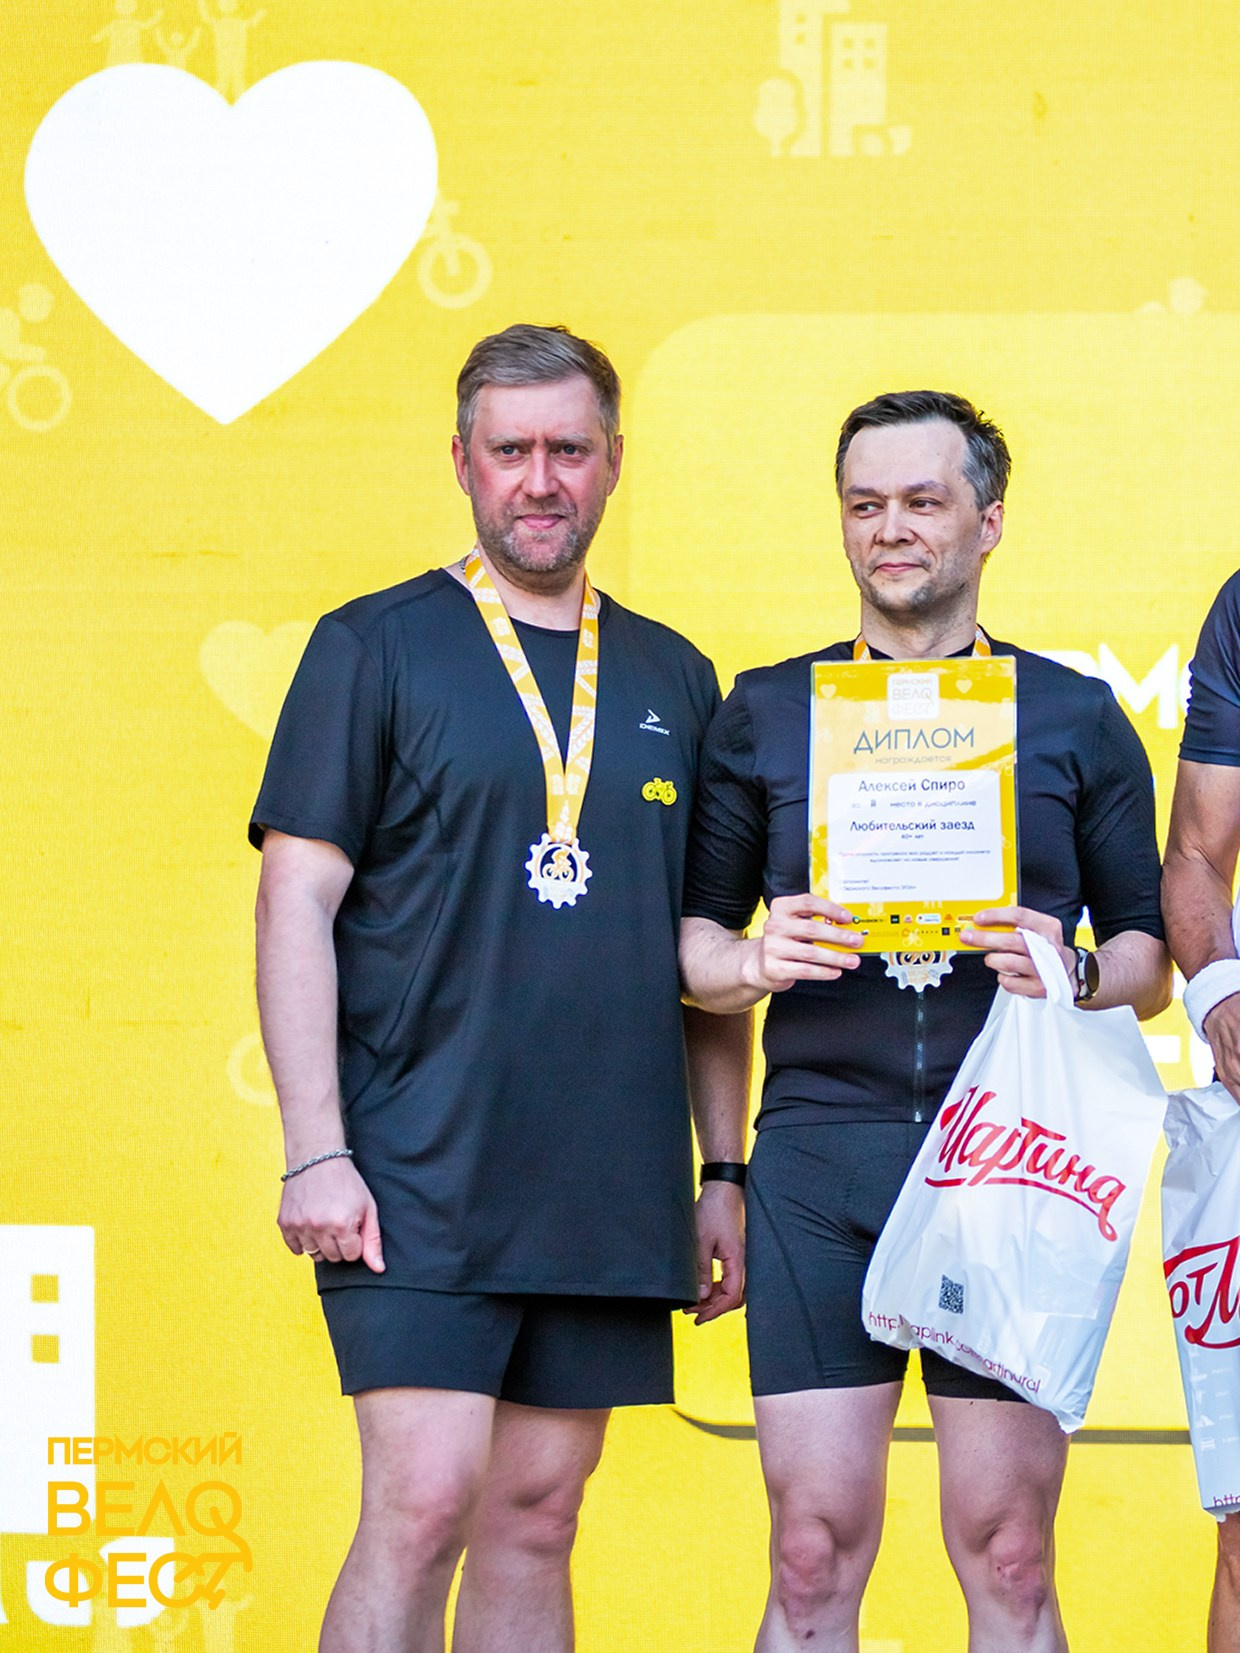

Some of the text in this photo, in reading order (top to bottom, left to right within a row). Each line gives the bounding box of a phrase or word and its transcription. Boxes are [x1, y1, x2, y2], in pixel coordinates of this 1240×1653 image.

[853, 727, 974, 754] ДИПЛОМ
[875, 755, 952, 765] награждается
[857, 778, 966, 792] Алексей Спиро
[850, 819, 976, 831] Любительский заезд
